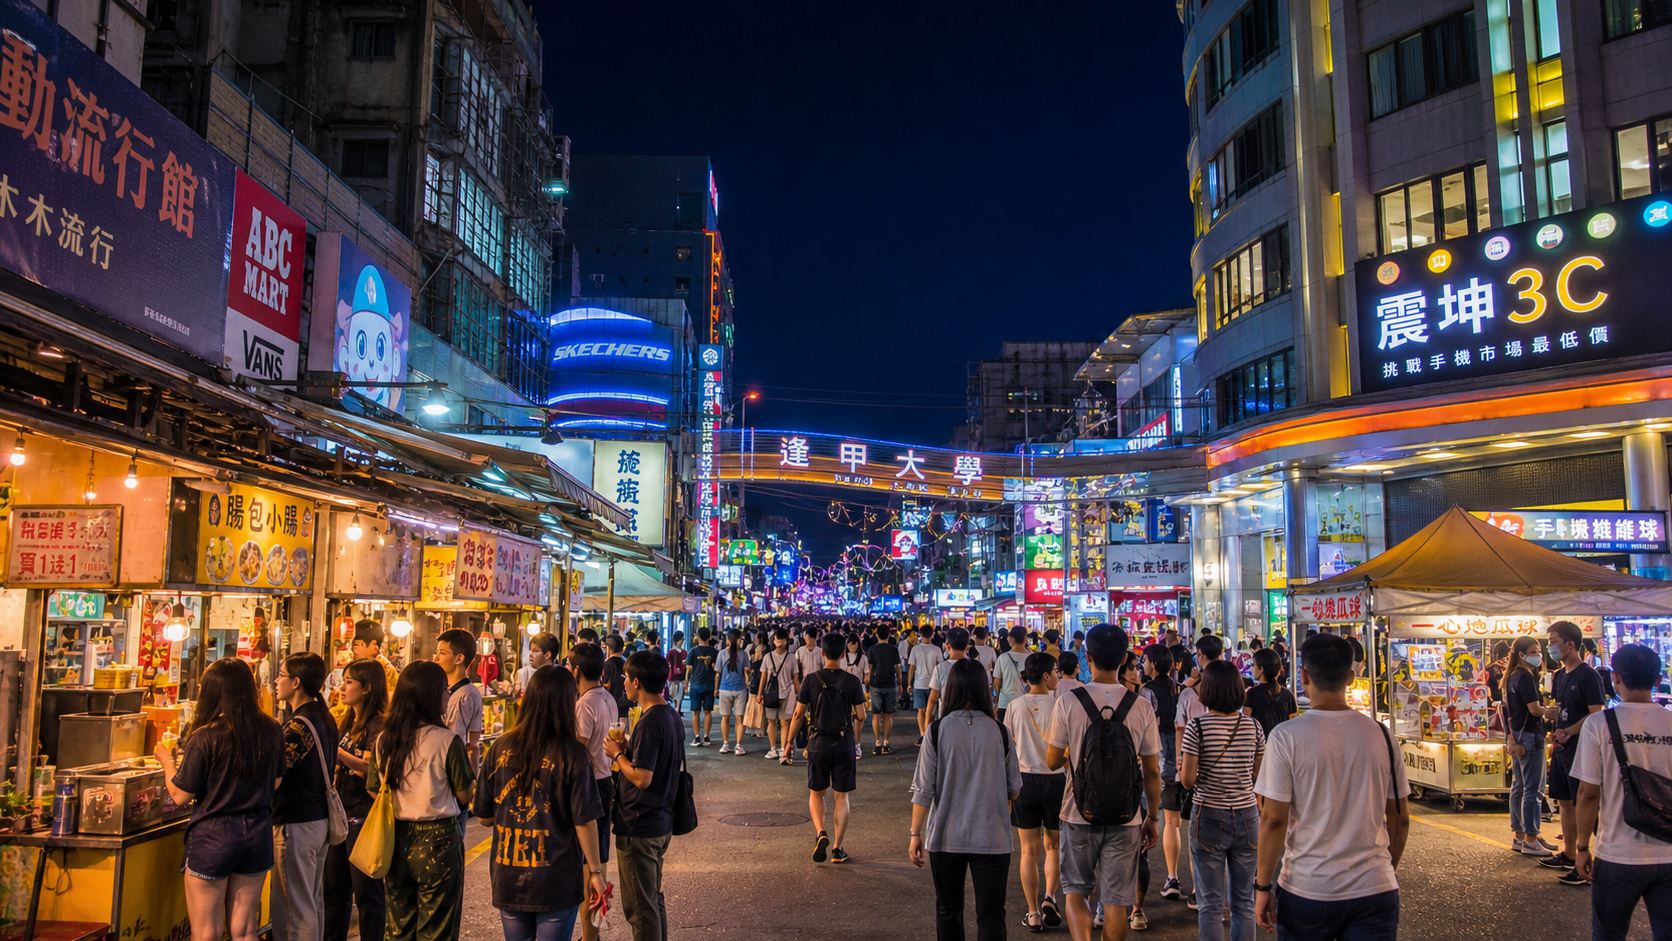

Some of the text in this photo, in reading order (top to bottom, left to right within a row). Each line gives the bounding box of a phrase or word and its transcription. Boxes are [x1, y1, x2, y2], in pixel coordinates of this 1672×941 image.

[246, 207, 293, 280] ABC
[243, 260, 289, 316] MART
[243, 330, 285, 381] VANS
[553, 343, 671, 362] SKECHERS
[1383, 325, 1609, 378] 挑戰手機市場最低價
[780, 437, 983, 485] 逢甲大學
[226, 494, 298, 537] 腸包小腸
[1411, 618, 1538, 635] 一心地瓜球
